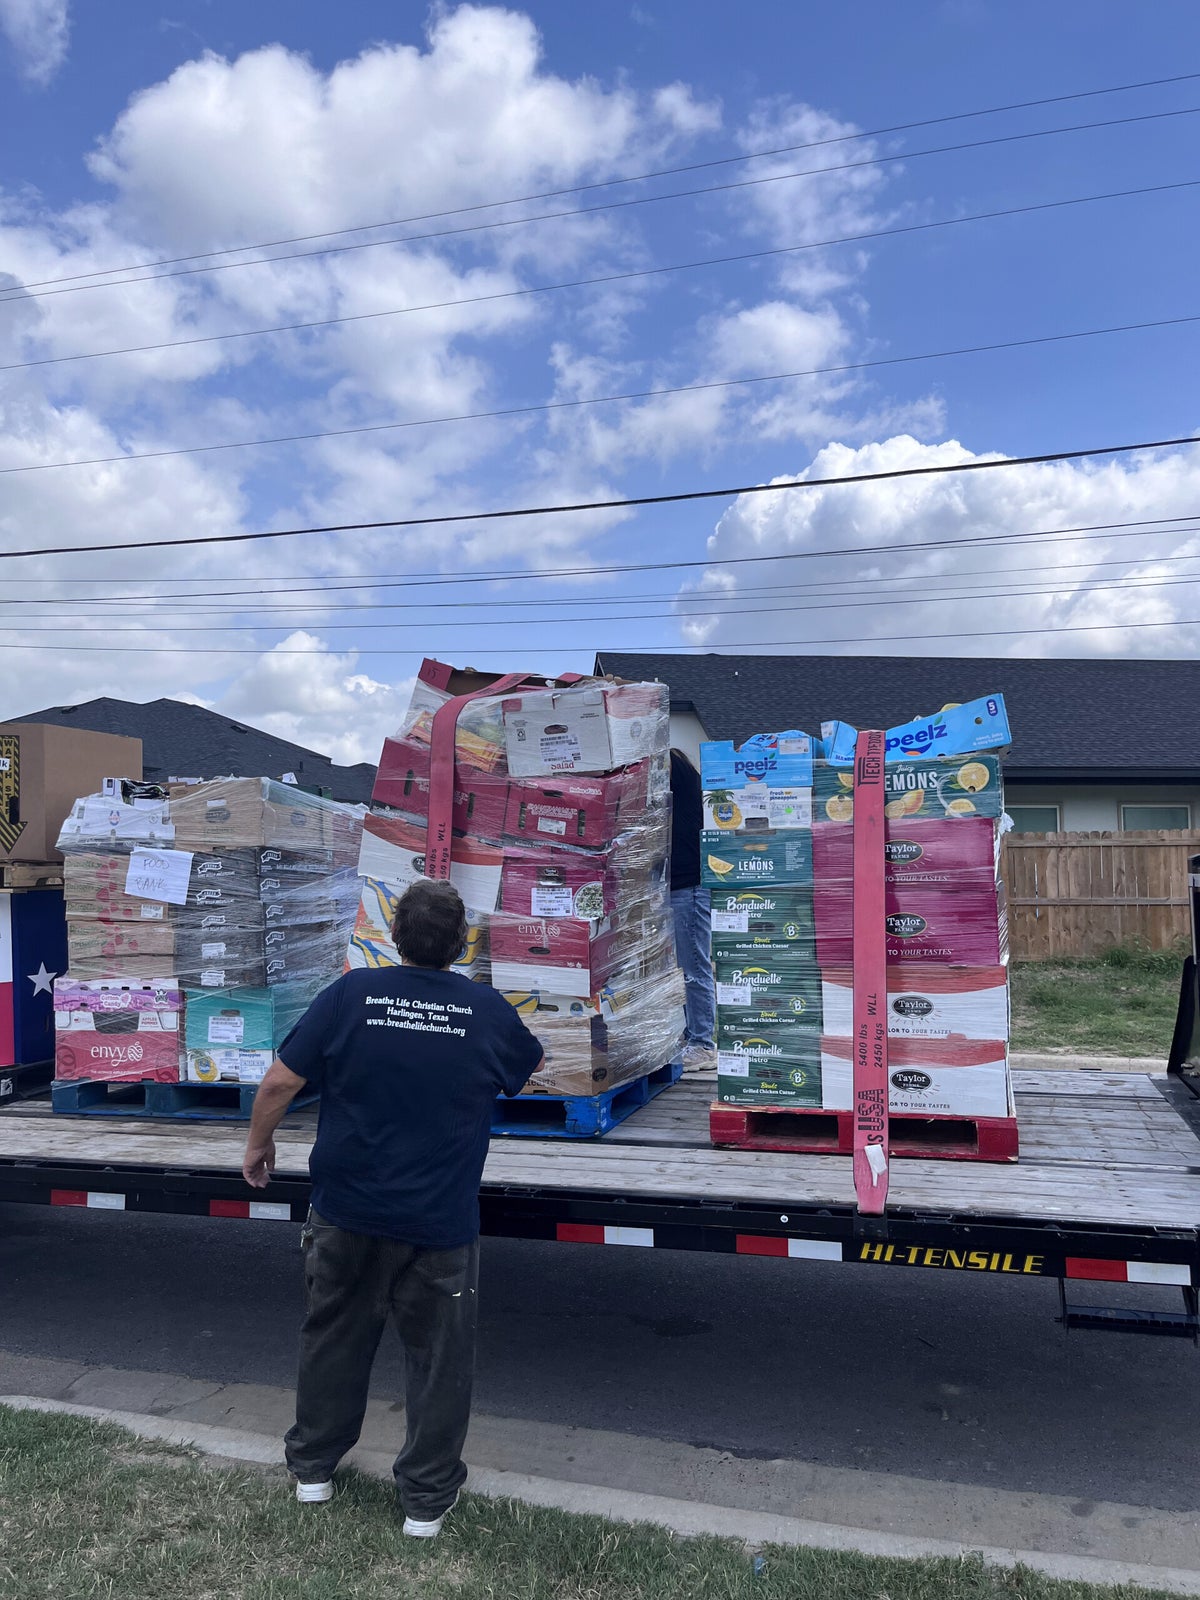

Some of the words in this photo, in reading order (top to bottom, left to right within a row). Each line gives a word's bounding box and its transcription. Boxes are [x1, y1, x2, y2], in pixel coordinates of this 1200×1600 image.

[987, 701, 996, 711] 5
[885, 723, 948, 752] peelz
[551, 761, 575, 770] Salad
[735, 756, 777, 774] peelz
[885, 771, 938, 791] EMONS
[437, 822, 445, 841] WLL
[429, 848, 437, 862] lbs
[440, 847, 449, 863] kgs
[885, 843, 918, 854] Taylor
[143, 858, 169, 870] FOOD
[738, 860, 774, 871] LEMONS
[725, 896, 776, 912] Bonduelle
[887, 917, 921, 928] Taylor
[518, 924, 546, 940] envy
[922, 948, 953, 956] TASTES
[731, 969, 782, 986] Bonduelle
[365, 996, 394, 1005] Breathe
[396, 998, 411, 1007] Life
[411, 1000, 445, 1011] Christian
[446, 1004, 473, 1015] Church
[867, 993, 877, 1016] WLL
[898, 1000, 929, 1009] Taylor
[386, 1006, 425, 1020] Harlingen,
[427, 1011, 449, 1022] Texas
[366, 1017, 466, 1037] www.breathelifechurch.org
[858, 1023, 868, 1040] lbs
[873, 1023, 884, 1041] kgs
[90, 1045, 128, 1067] envy
[732, 1040, 783, 1056] Bonduelle
[858, 1042, 868, 1066] 5400
[874, 1043, 883, 1068] 2450
[896, 1074, 926, 1083] Taylor
[858, 1089, 884, 1131] USA
[860, 1242, 1045, 1274] HI-TENSILE
